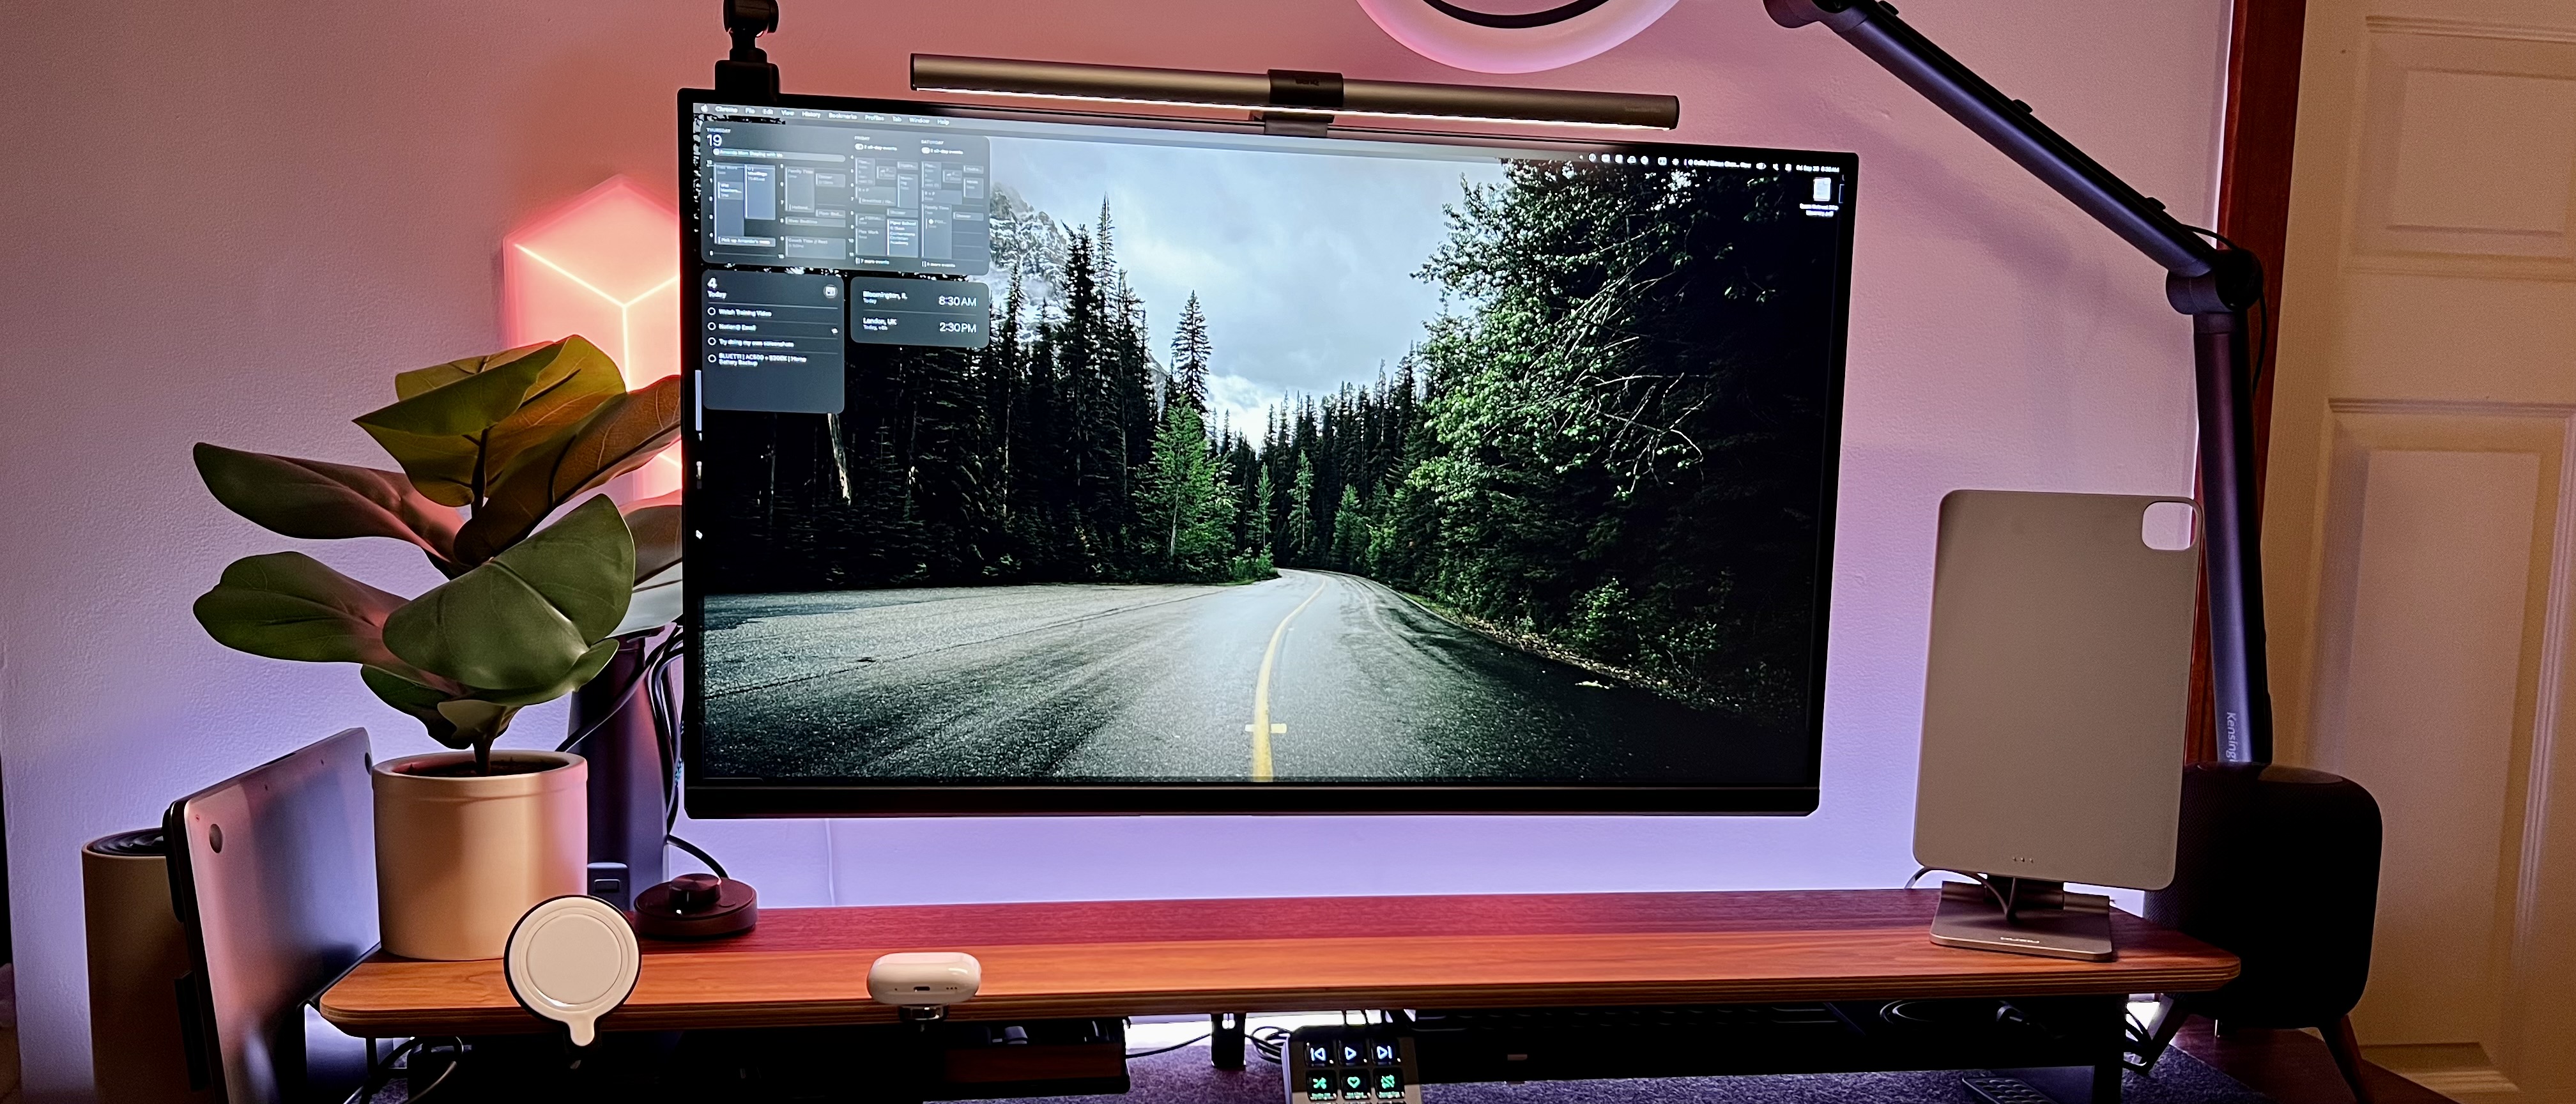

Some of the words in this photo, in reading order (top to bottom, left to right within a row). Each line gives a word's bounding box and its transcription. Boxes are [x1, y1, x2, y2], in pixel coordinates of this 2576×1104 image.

[706, 134, 723, 147] 19
[707, 277, 717, 289] 4
[707, 290, 727, 300] Today
[862, 291, 901, 300] Bloomington,
[735, 309, 756, 318] Training
[862, 318, 887, 326] London,
